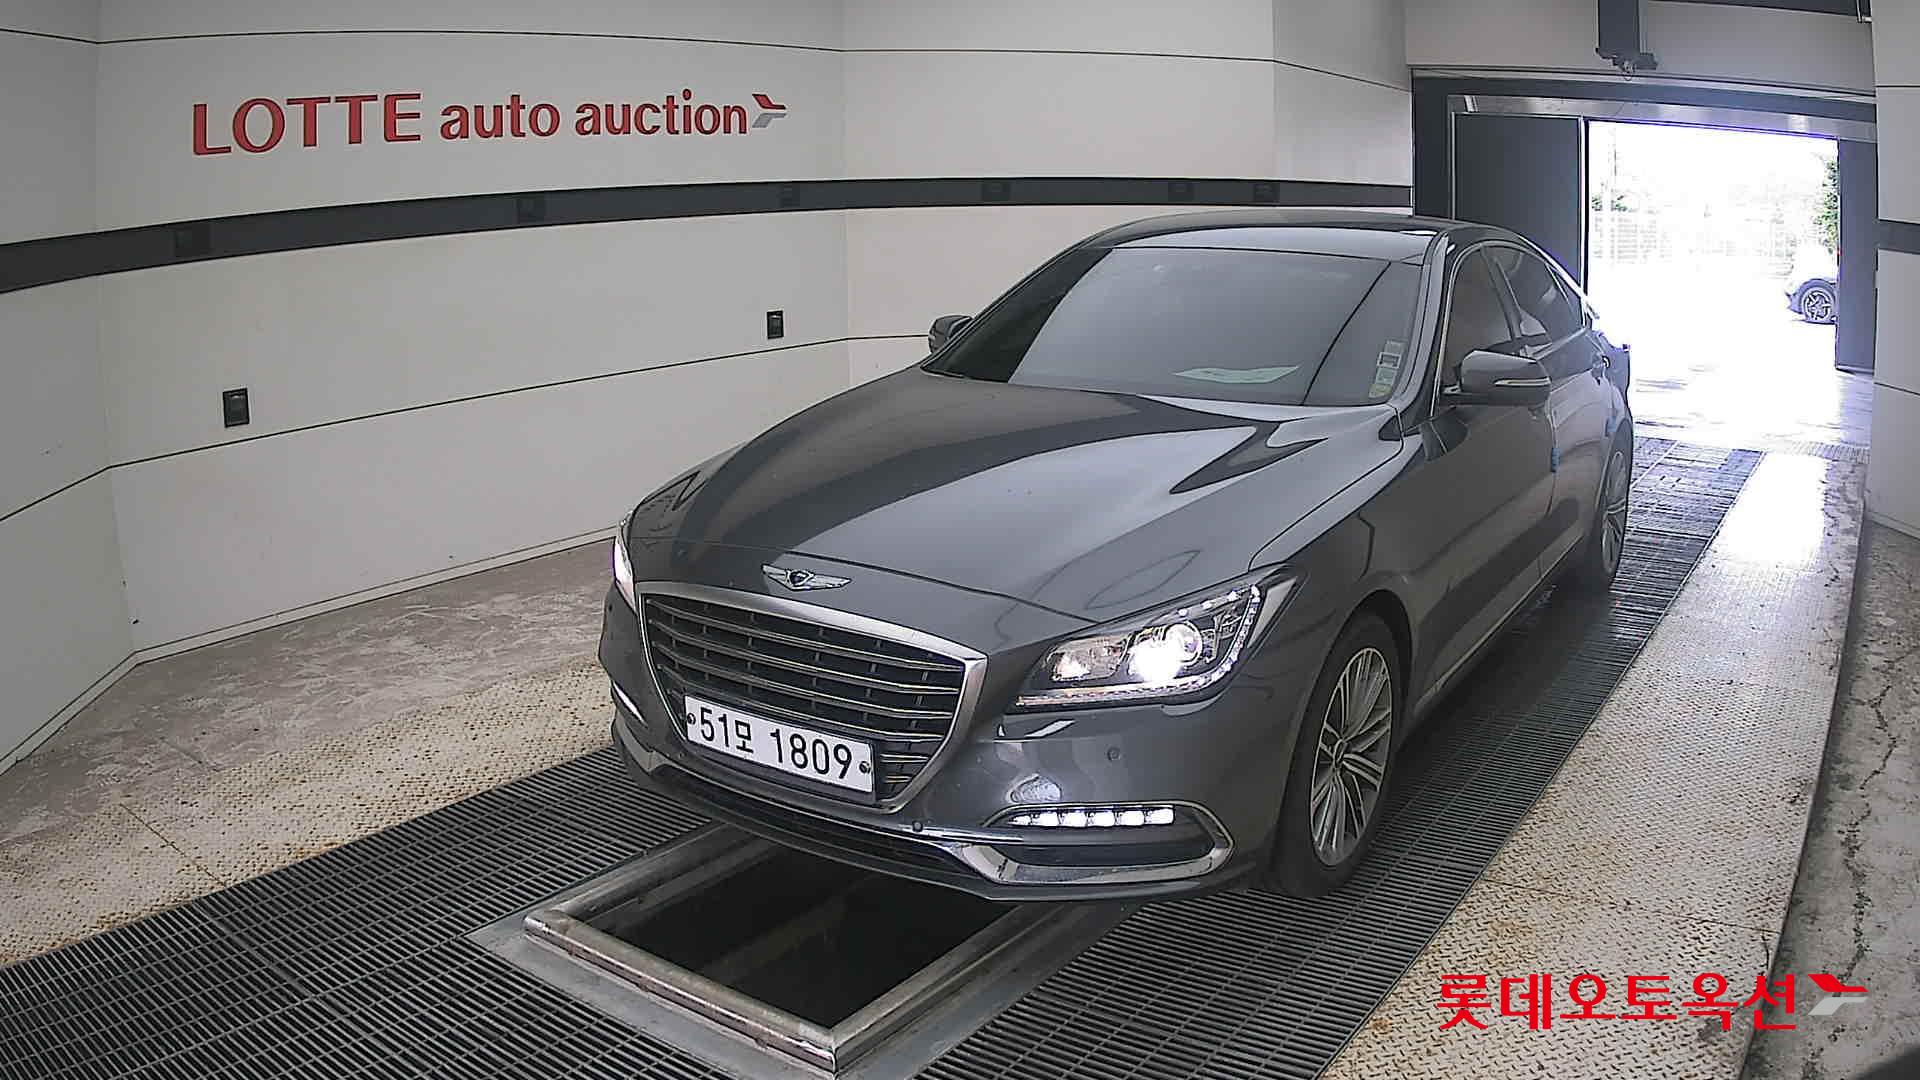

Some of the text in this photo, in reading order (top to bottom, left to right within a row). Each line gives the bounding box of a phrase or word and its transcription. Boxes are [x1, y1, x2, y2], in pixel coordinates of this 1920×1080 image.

[192, 88, 747, 156] LOTTE auto auction
[700, 706, 852, 779] 51모 1809
